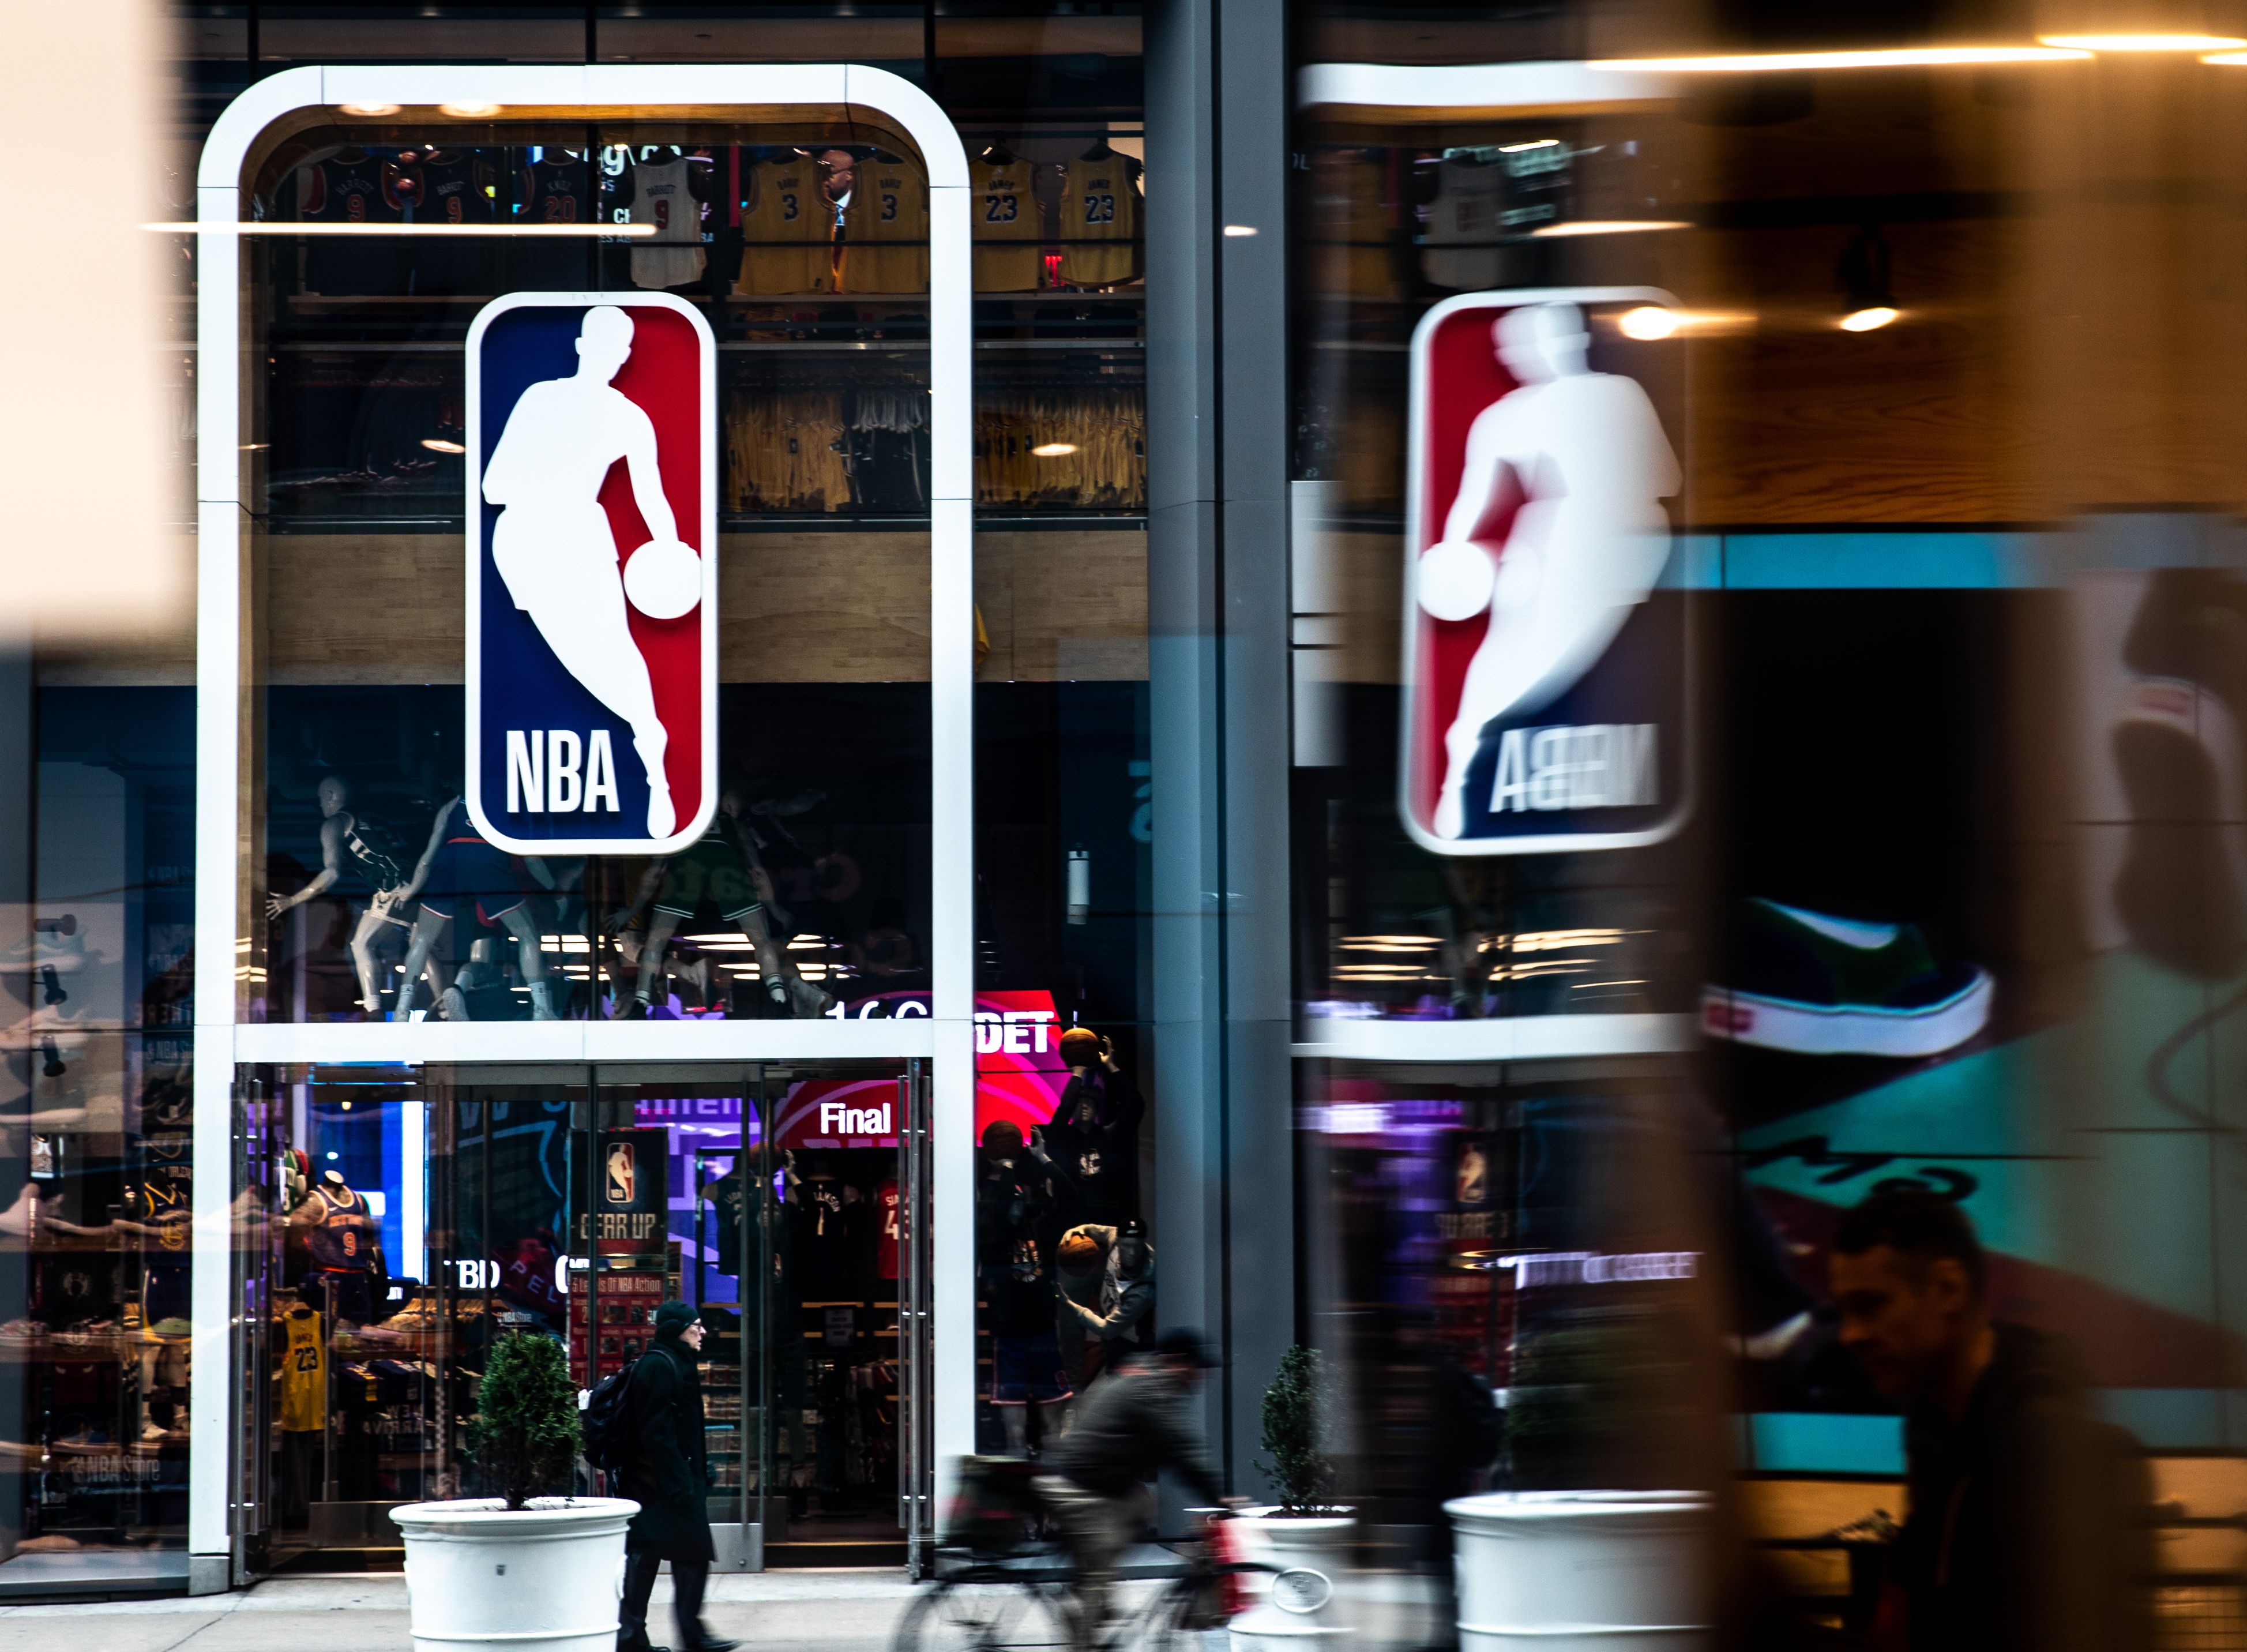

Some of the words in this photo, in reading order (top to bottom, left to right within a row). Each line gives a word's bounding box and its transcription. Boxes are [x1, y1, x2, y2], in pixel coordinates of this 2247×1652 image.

[347, 194, 366, 223] 9
[445, 196, 463, 223] 9
[544, 195, 576, 223] 20
[654, 200, 669, 229] 9
[782, 193, 799, 222] 3
[881, 193, 898, 222] 3
[986, 194, 1019, 224] 23
[1084, 194, 1115, 224] 23
[506, 729, 621, 813] NBA
[975, 1011, 1054, 1054] DET
[820, 1102, 892, 1135] Final
[632, 1213, 657, 1240] UP
[343, 1232, 356, 1256] 9
[579, 1277, 606, 1293] Lels
[618, 1276, 633, 1293] NBA
[634, 1276, 661, 1293] Action
[294, 1346, 319, 1372] 23
